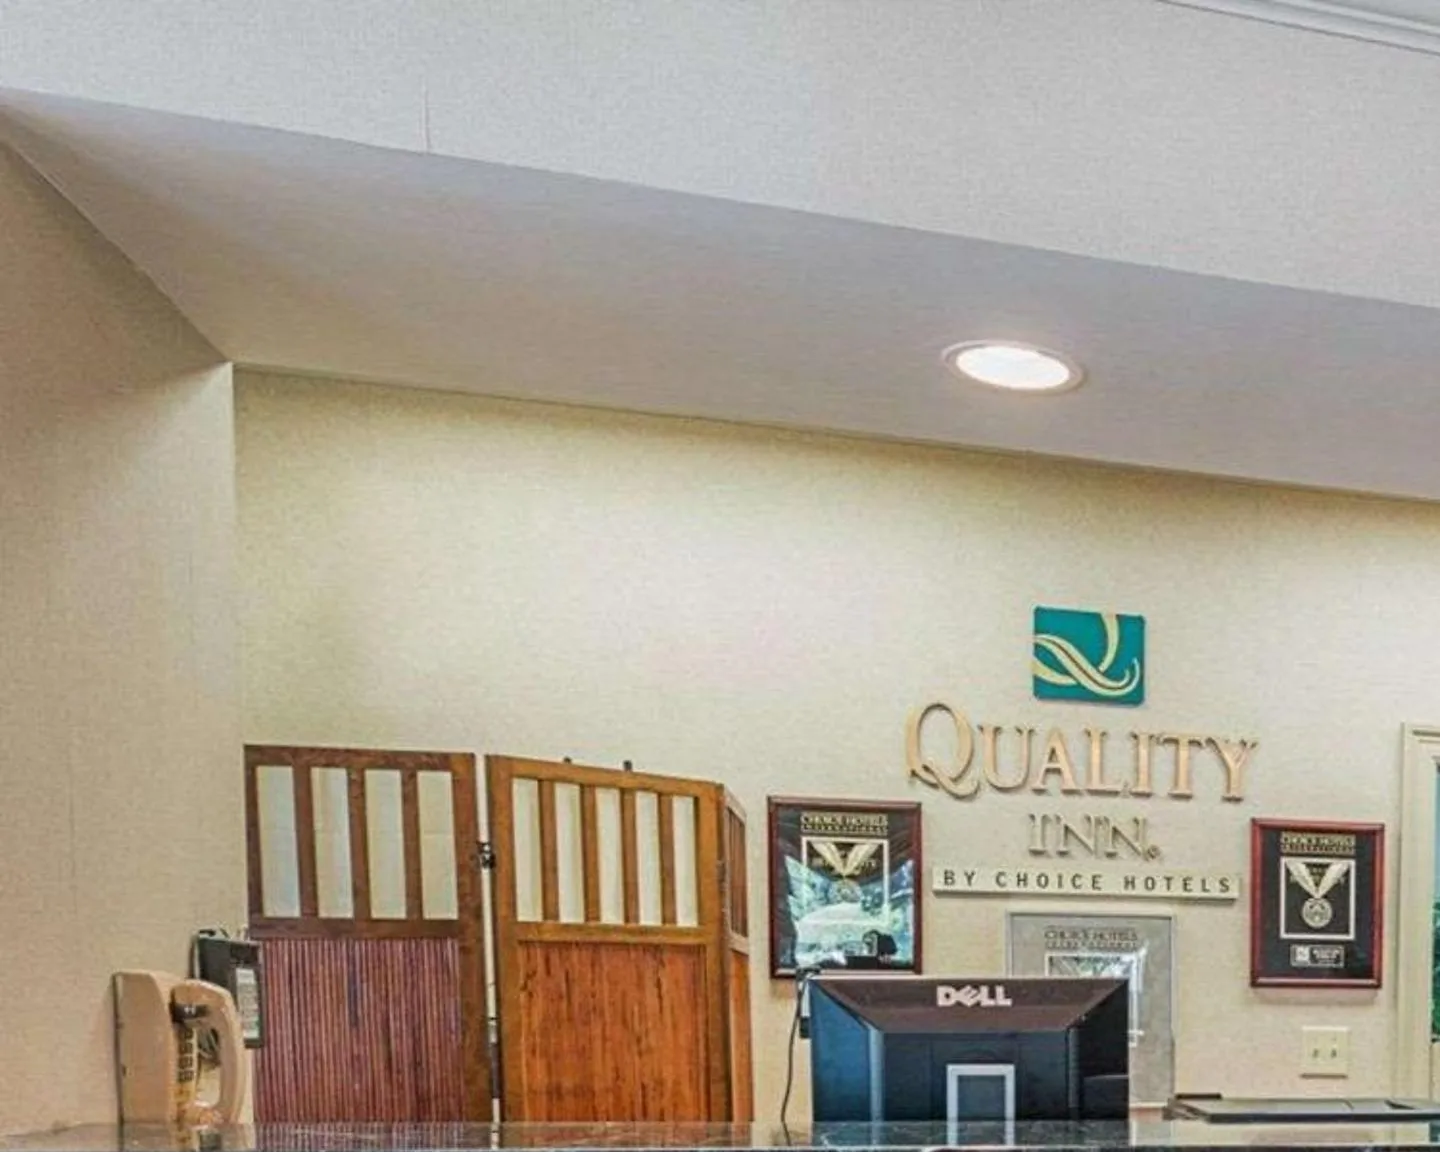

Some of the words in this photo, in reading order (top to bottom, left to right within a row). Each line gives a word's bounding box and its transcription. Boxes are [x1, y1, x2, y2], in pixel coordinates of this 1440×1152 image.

[905, 702, 1258, 802] QUALITY
[943, 869, 977, 887] BY
[995, 871, 1102, 890] CHOICE
[1123, 875, 1231, 893] HOTELS
[936, 984, 1013, 1007] DELL
